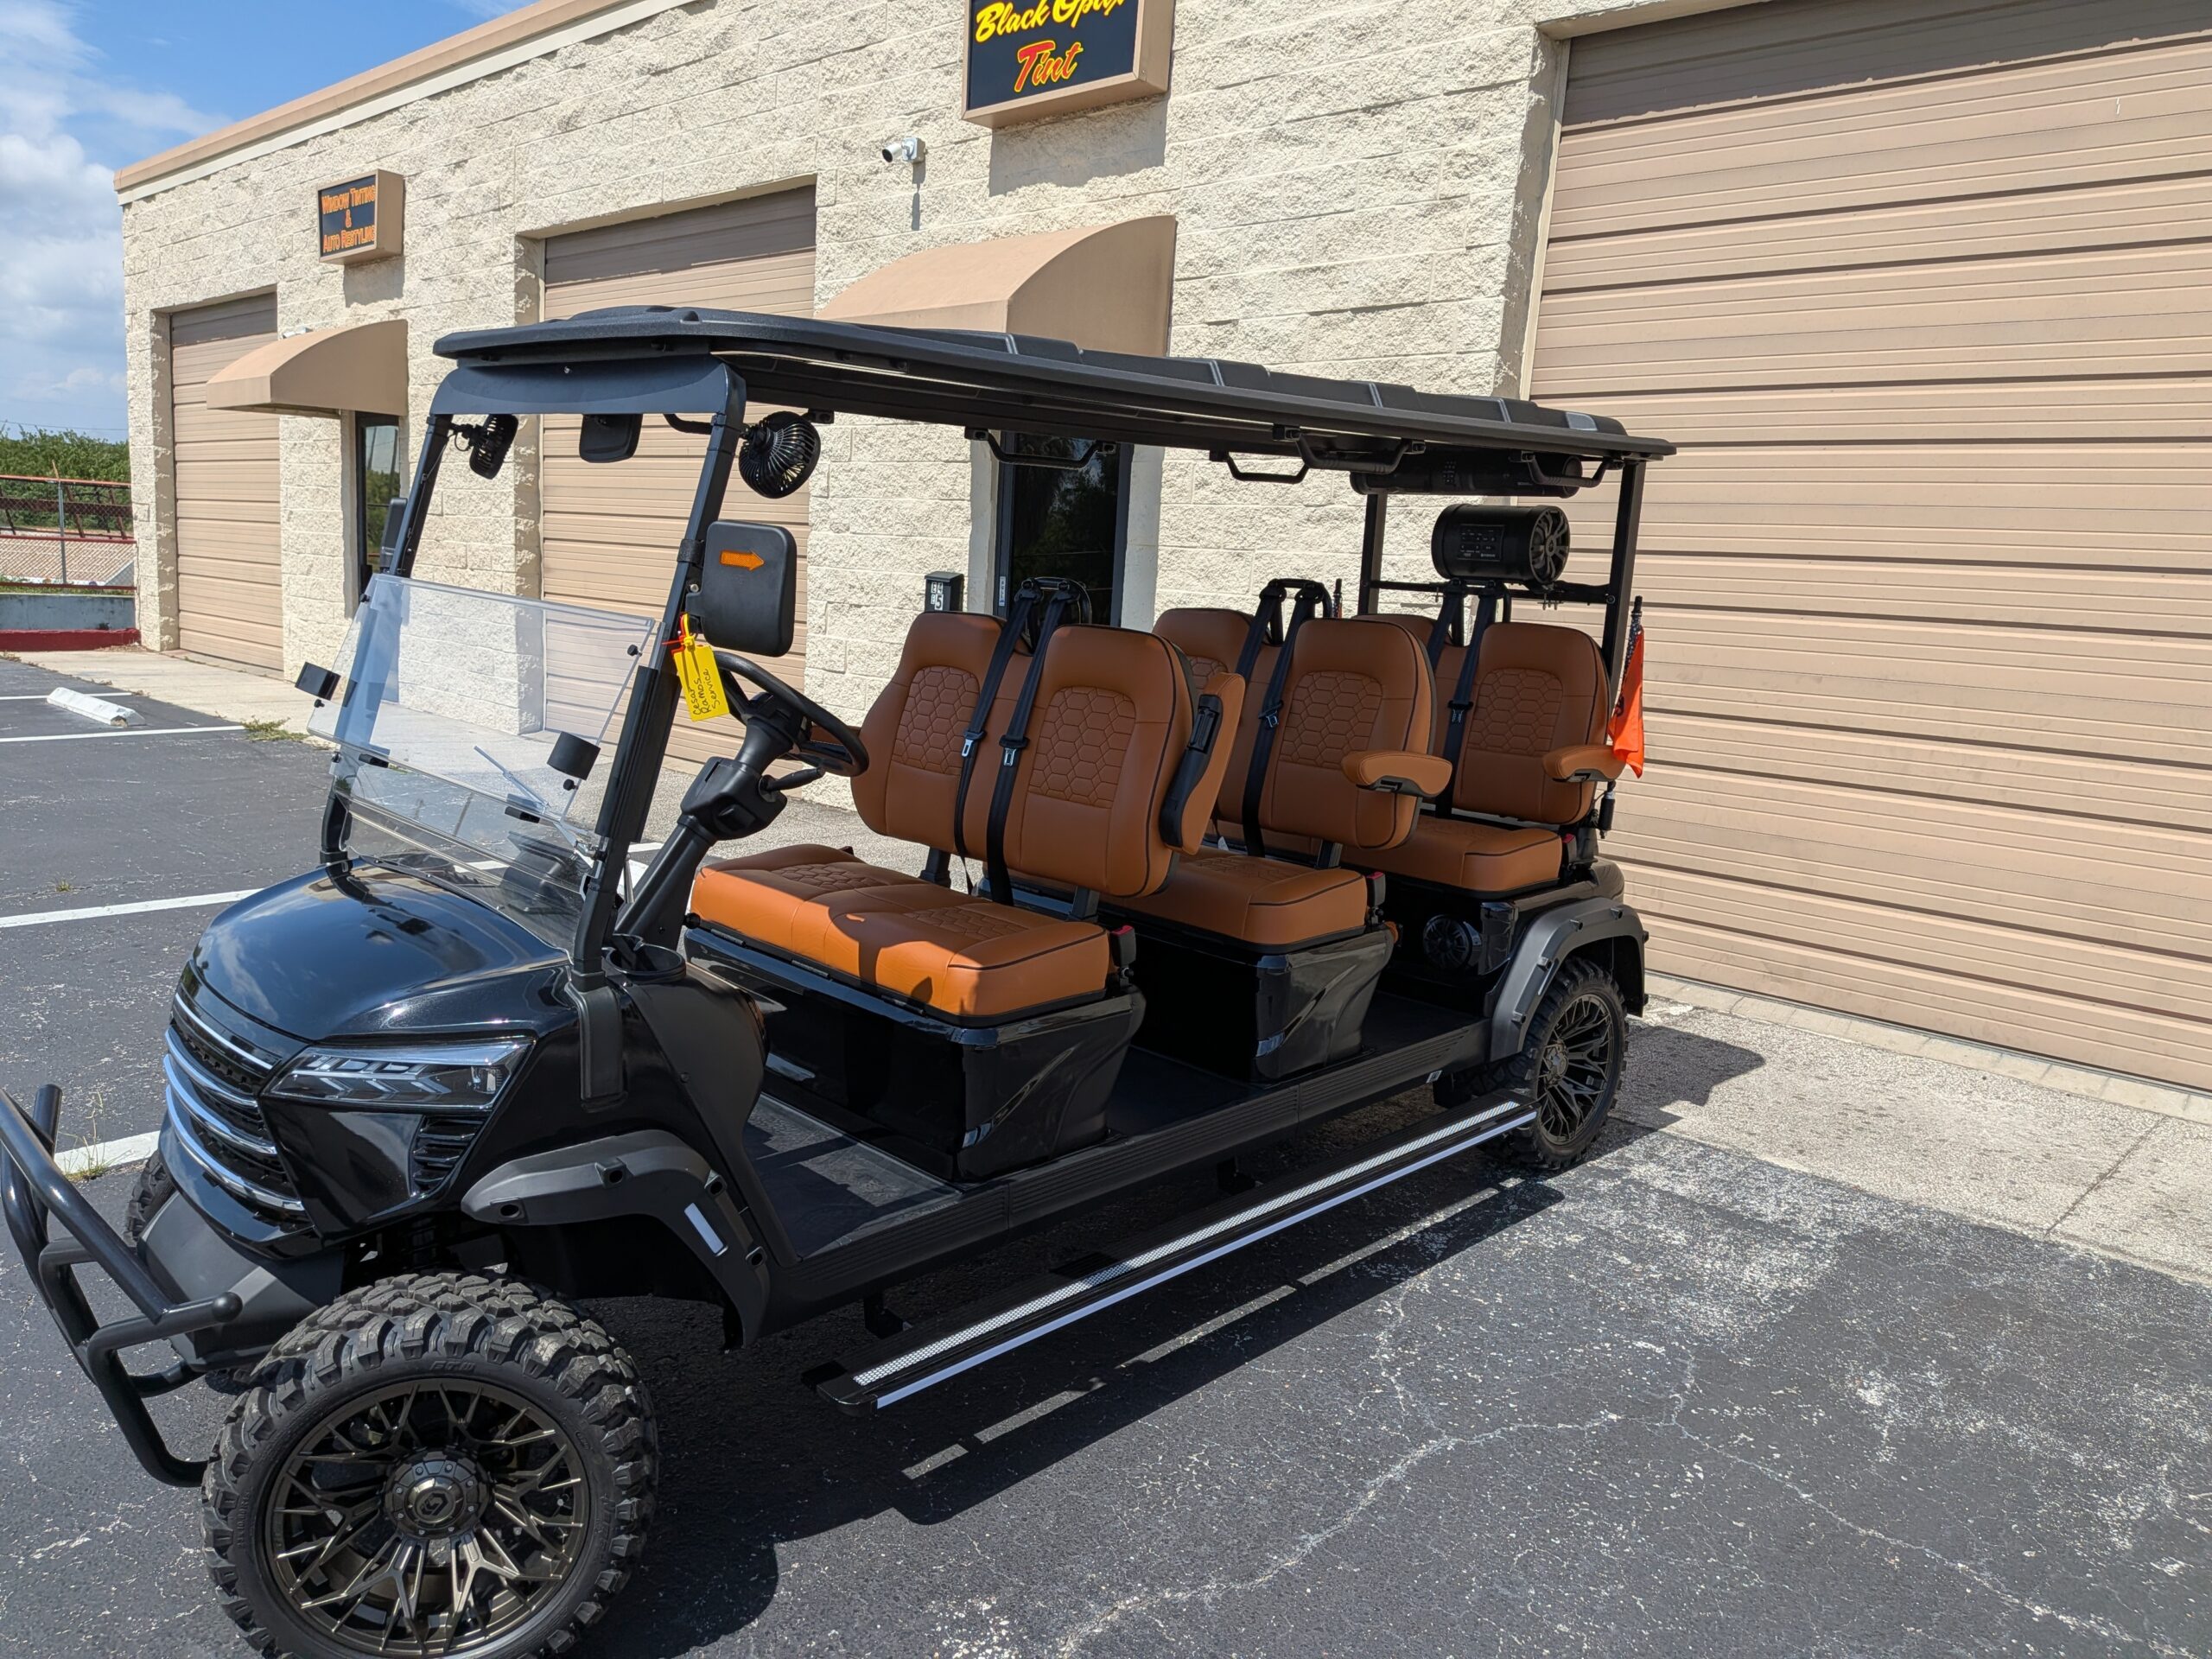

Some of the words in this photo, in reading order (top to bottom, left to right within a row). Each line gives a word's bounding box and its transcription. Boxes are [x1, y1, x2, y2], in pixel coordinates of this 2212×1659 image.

[976, 0, 1051, 42] Black
[1014, 40, 1084, 92] Tint
[346, 209, 352, 227] &
[694, 678, 711, 713] Ramos
